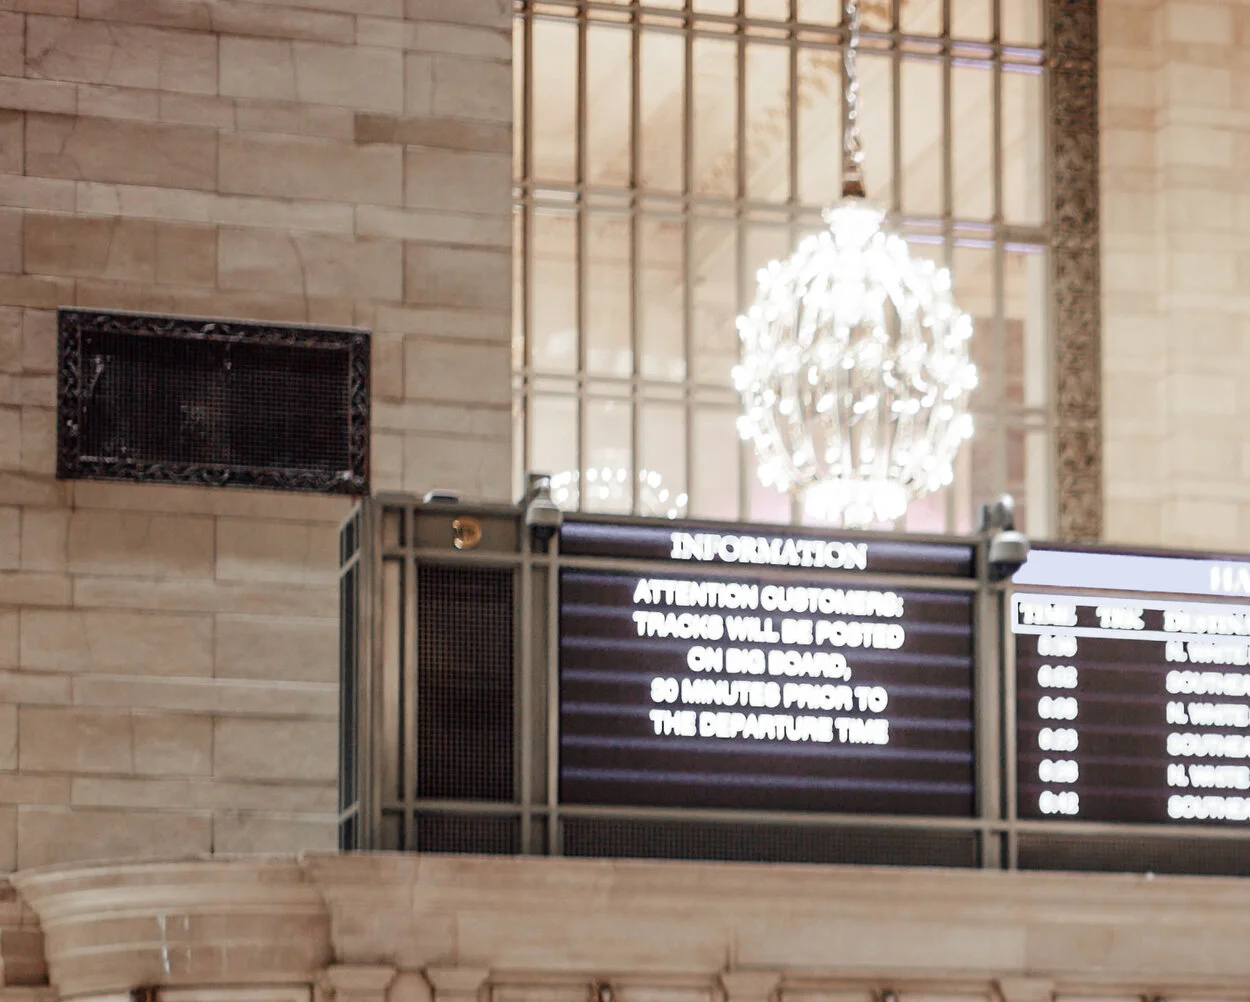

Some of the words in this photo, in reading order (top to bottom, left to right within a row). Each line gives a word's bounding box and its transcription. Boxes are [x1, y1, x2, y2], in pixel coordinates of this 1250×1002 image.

[671, 532, 868, 570] INFORMATION
[633, 579, 758, 610] ATTENTION
[632, 611, 724, 640] TRACKS
[726, 615, 780, 643] WILL
[782, 618, 813, 645] BE
[816, 620, 905, 649] POSTED
[687, 646, 723, 673] ON
[681, 678, 781, 708] MINUTES
[783, 682, 853, 711] PRIOR
[854, 686, 889, 713] TO
[649, 709, 697, 738] THE
[700, 711, 833, 743] DEPARTURE
[834, 716, 889, 745] TIME
